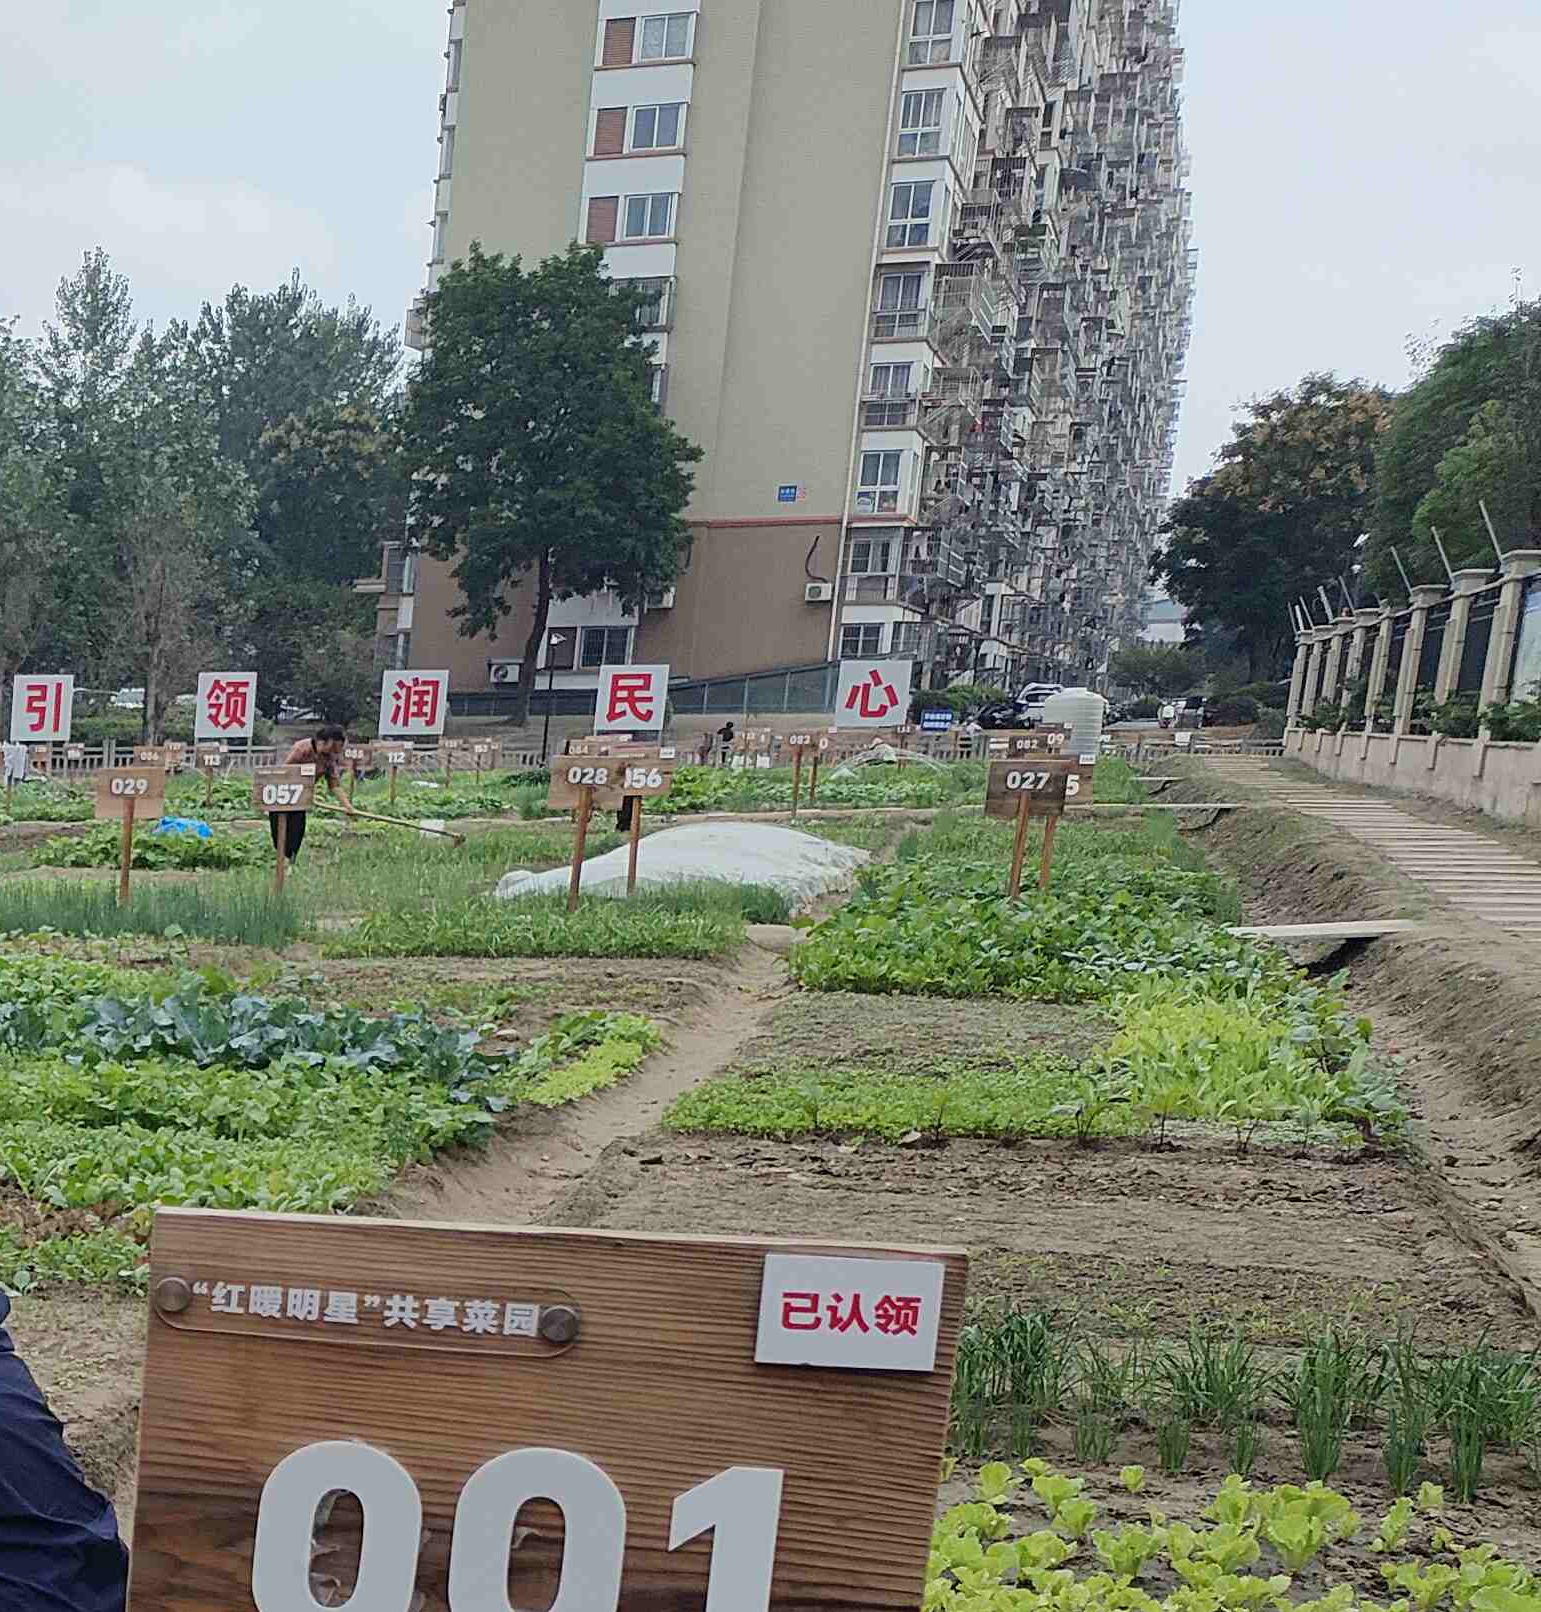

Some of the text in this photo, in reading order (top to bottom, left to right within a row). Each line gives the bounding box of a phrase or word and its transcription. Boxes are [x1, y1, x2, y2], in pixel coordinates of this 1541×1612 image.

[25, 682, 63, 733] 引
[206, 679, 250, 730] 领
[390, 676, 440, 727] 润
[606, 673, 654, 723] 民
[845, 669, 899, 718] 心
[388, 752, 406, 764] 112
[567, 765, 609, 786] 028
[1005, 769, 1052, 791] 027
[111, 778, 149, 796] 029
[262, 784, 304, 805] 057
[780, 1290, 922, 1336] 已认领
